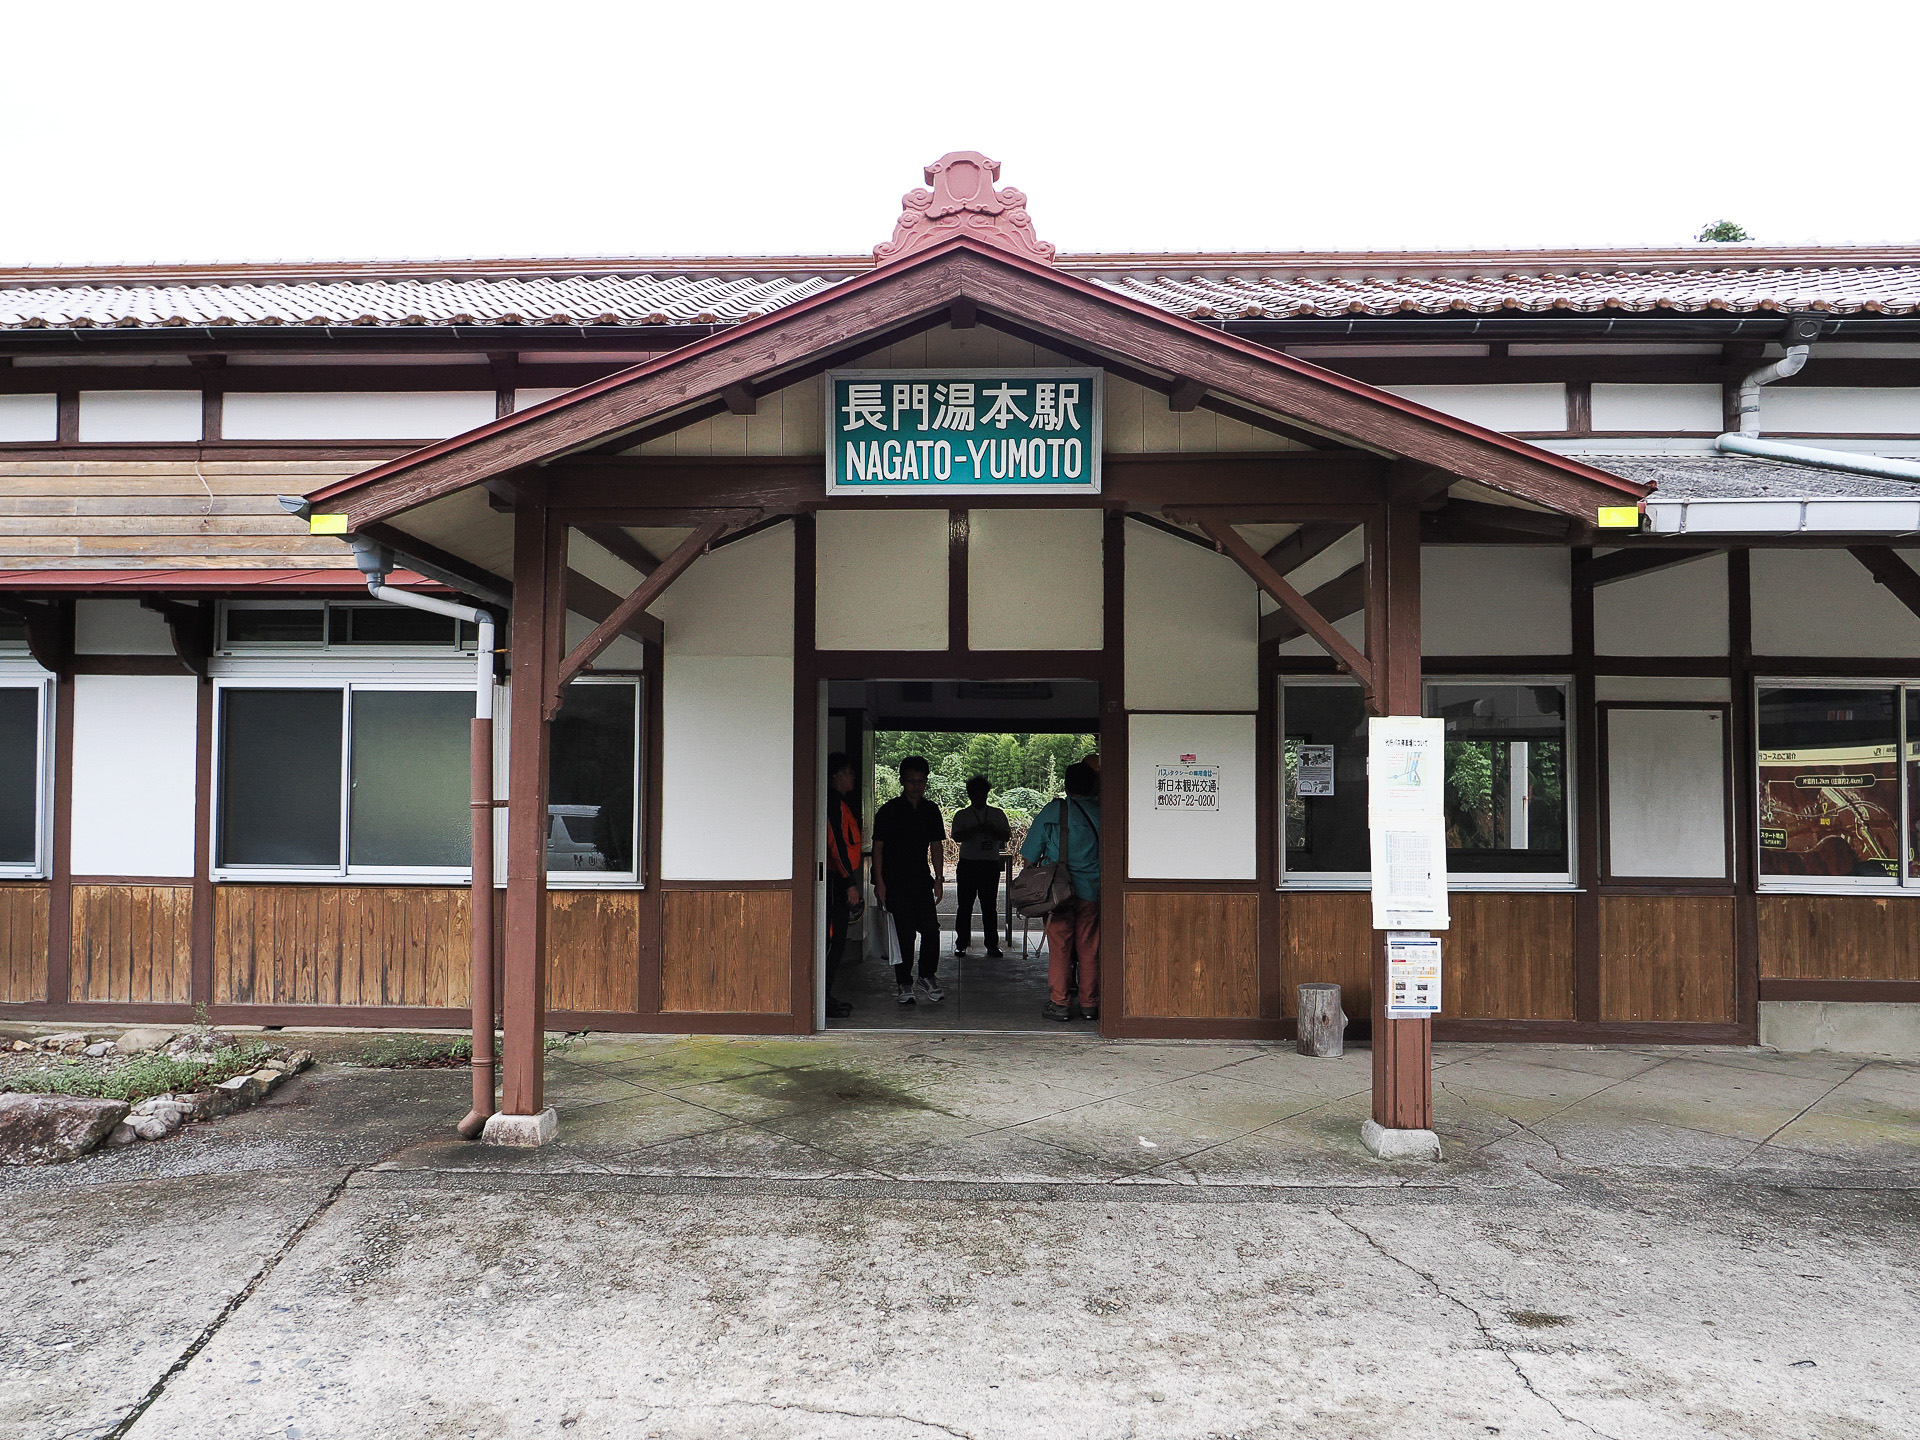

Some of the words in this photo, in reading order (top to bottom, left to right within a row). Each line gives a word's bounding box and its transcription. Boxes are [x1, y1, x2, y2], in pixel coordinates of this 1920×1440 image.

[841, 382, 1081, 431] 長門湯本駅
[845, 438, 1083, 480] NAGATO-YUMOTO
[1158, 779, 1216, 792] 新日本観光交通
